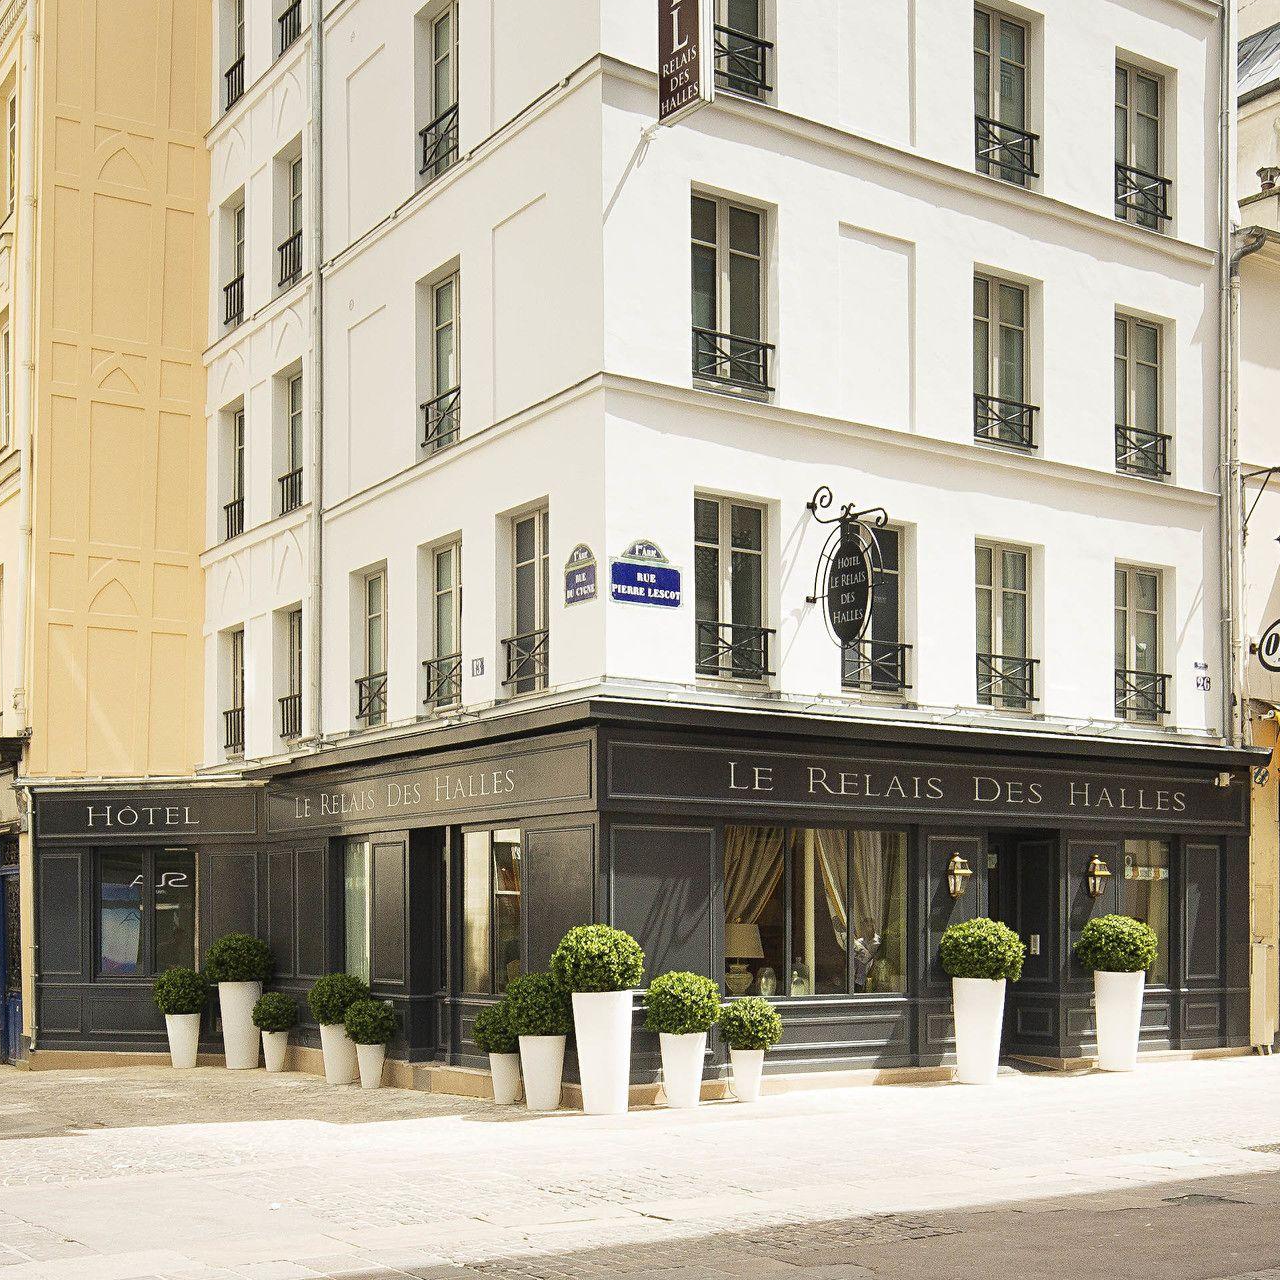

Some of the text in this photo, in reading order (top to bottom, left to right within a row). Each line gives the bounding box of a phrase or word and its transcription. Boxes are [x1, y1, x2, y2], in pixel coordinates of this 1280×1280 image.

[663, 45, 697, 75] RELAIS
[670, 71, 690, 93] DES
[662, 81, 699, 116] HALLES
[636, 572, 656, 583] RUE
[830, 571, 866, 589] LE RELAIS
[611, 583, 680, 600] PIERRE LESCOT
[840, 592, 855, 605] DES
[833, 608, 864, 624] HALLES
[1196, 676, 1211, 691] 26
[295, 769, 515, 819] LE RELAIS DES HALLES
[728, 761, 1187, 812] LE RELAIS DES HALLES
[87, 806, 200, 826] HÔTEL
